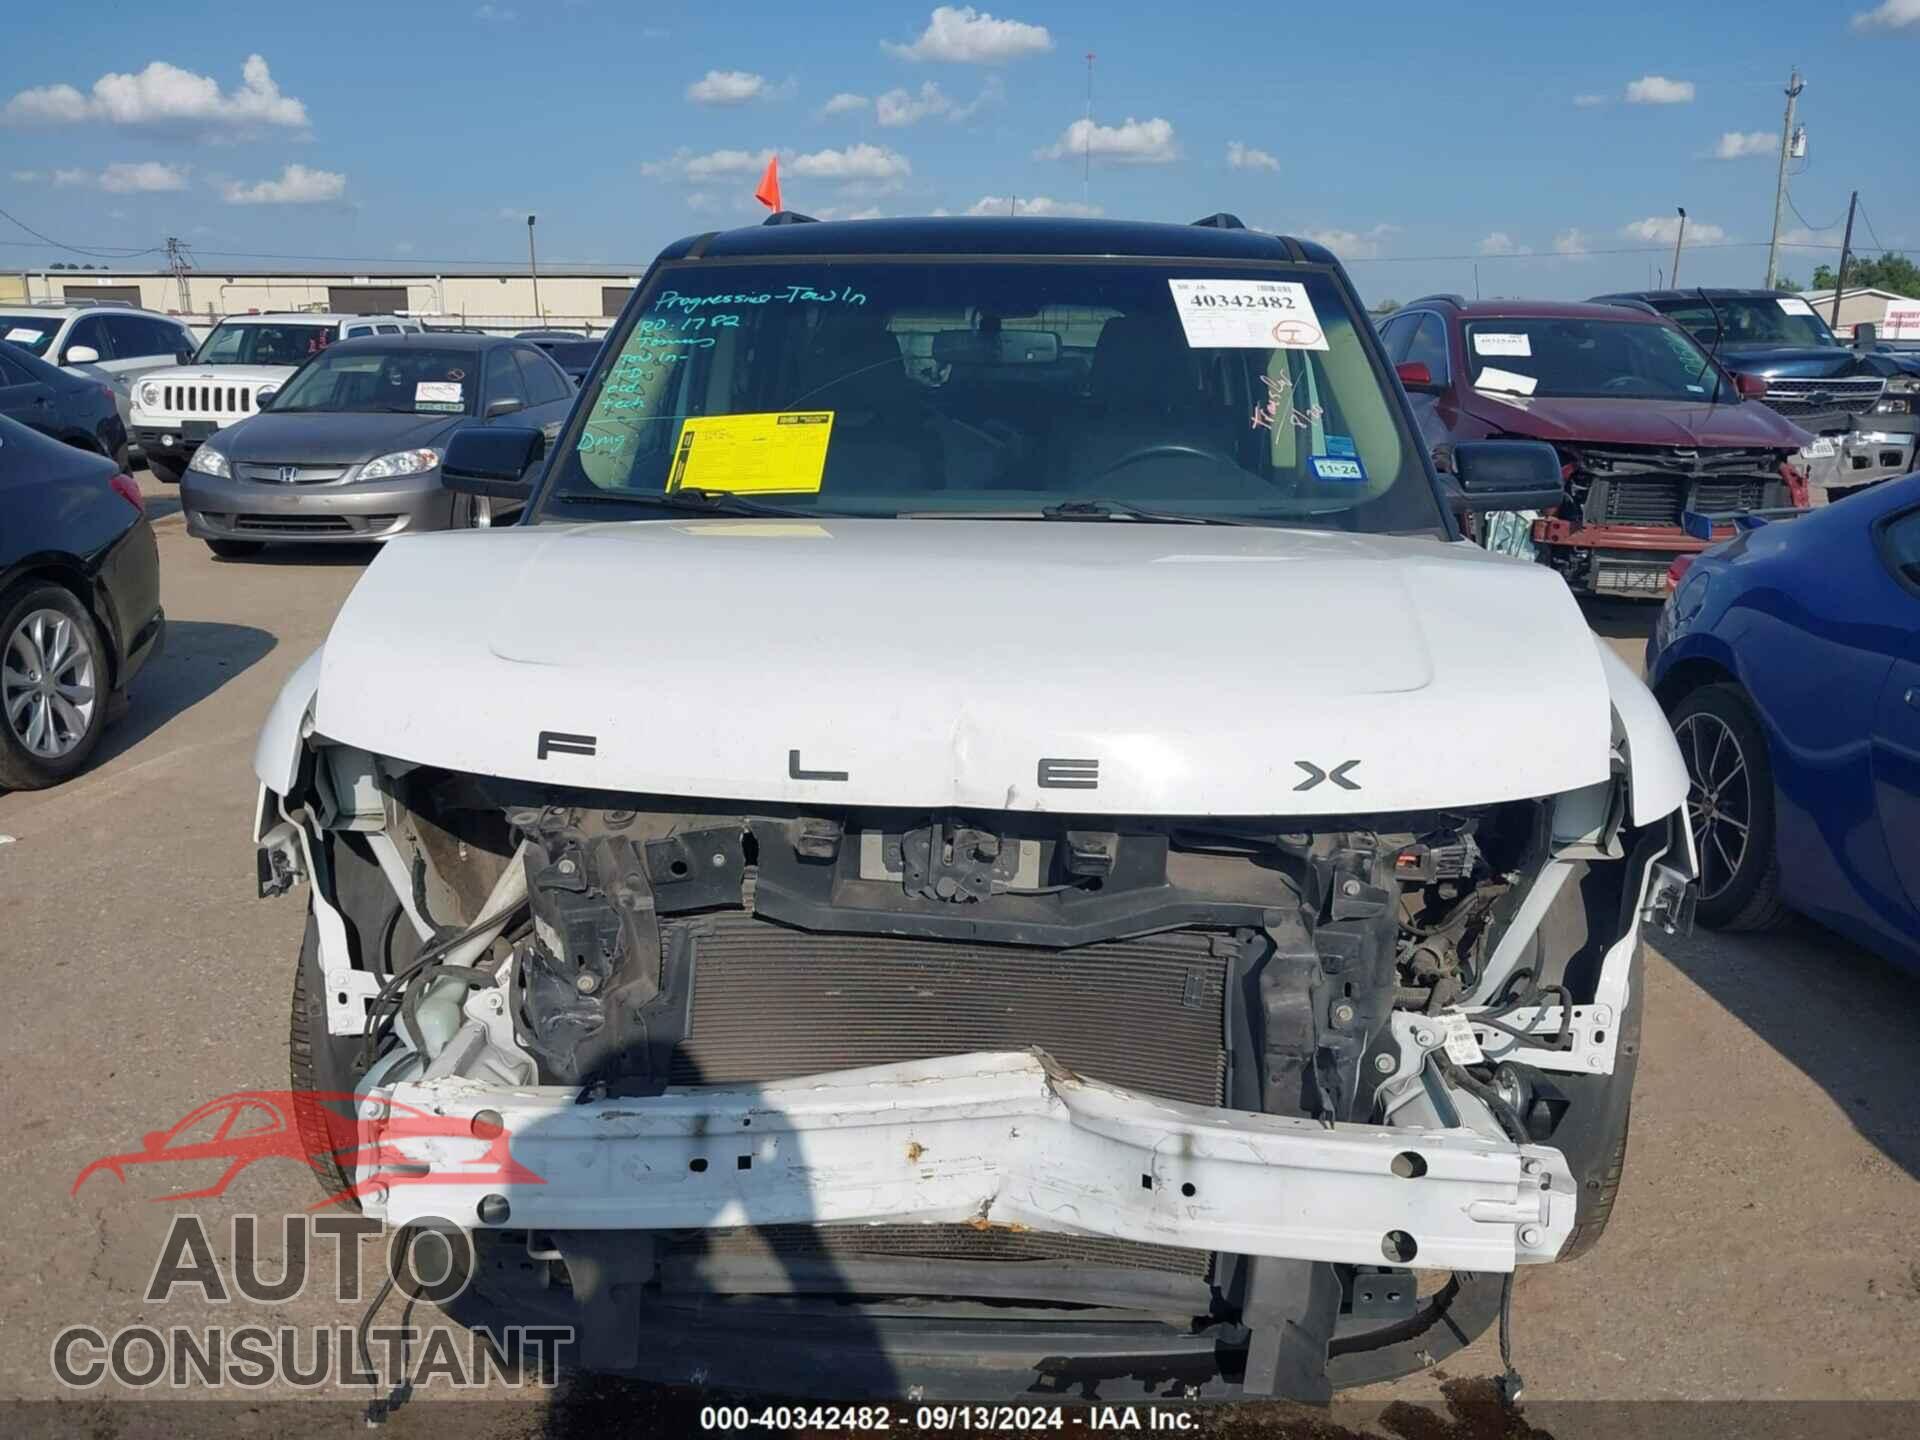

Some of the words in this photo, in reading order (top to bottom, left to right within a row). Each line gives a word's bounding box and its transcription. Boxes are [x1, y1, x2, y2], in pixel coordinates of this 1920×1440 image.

[1190, 294, 1296, 309] 40342482
[681, 315, 740, 331] 1782
[537, 730, 1362, 793] FLEX
